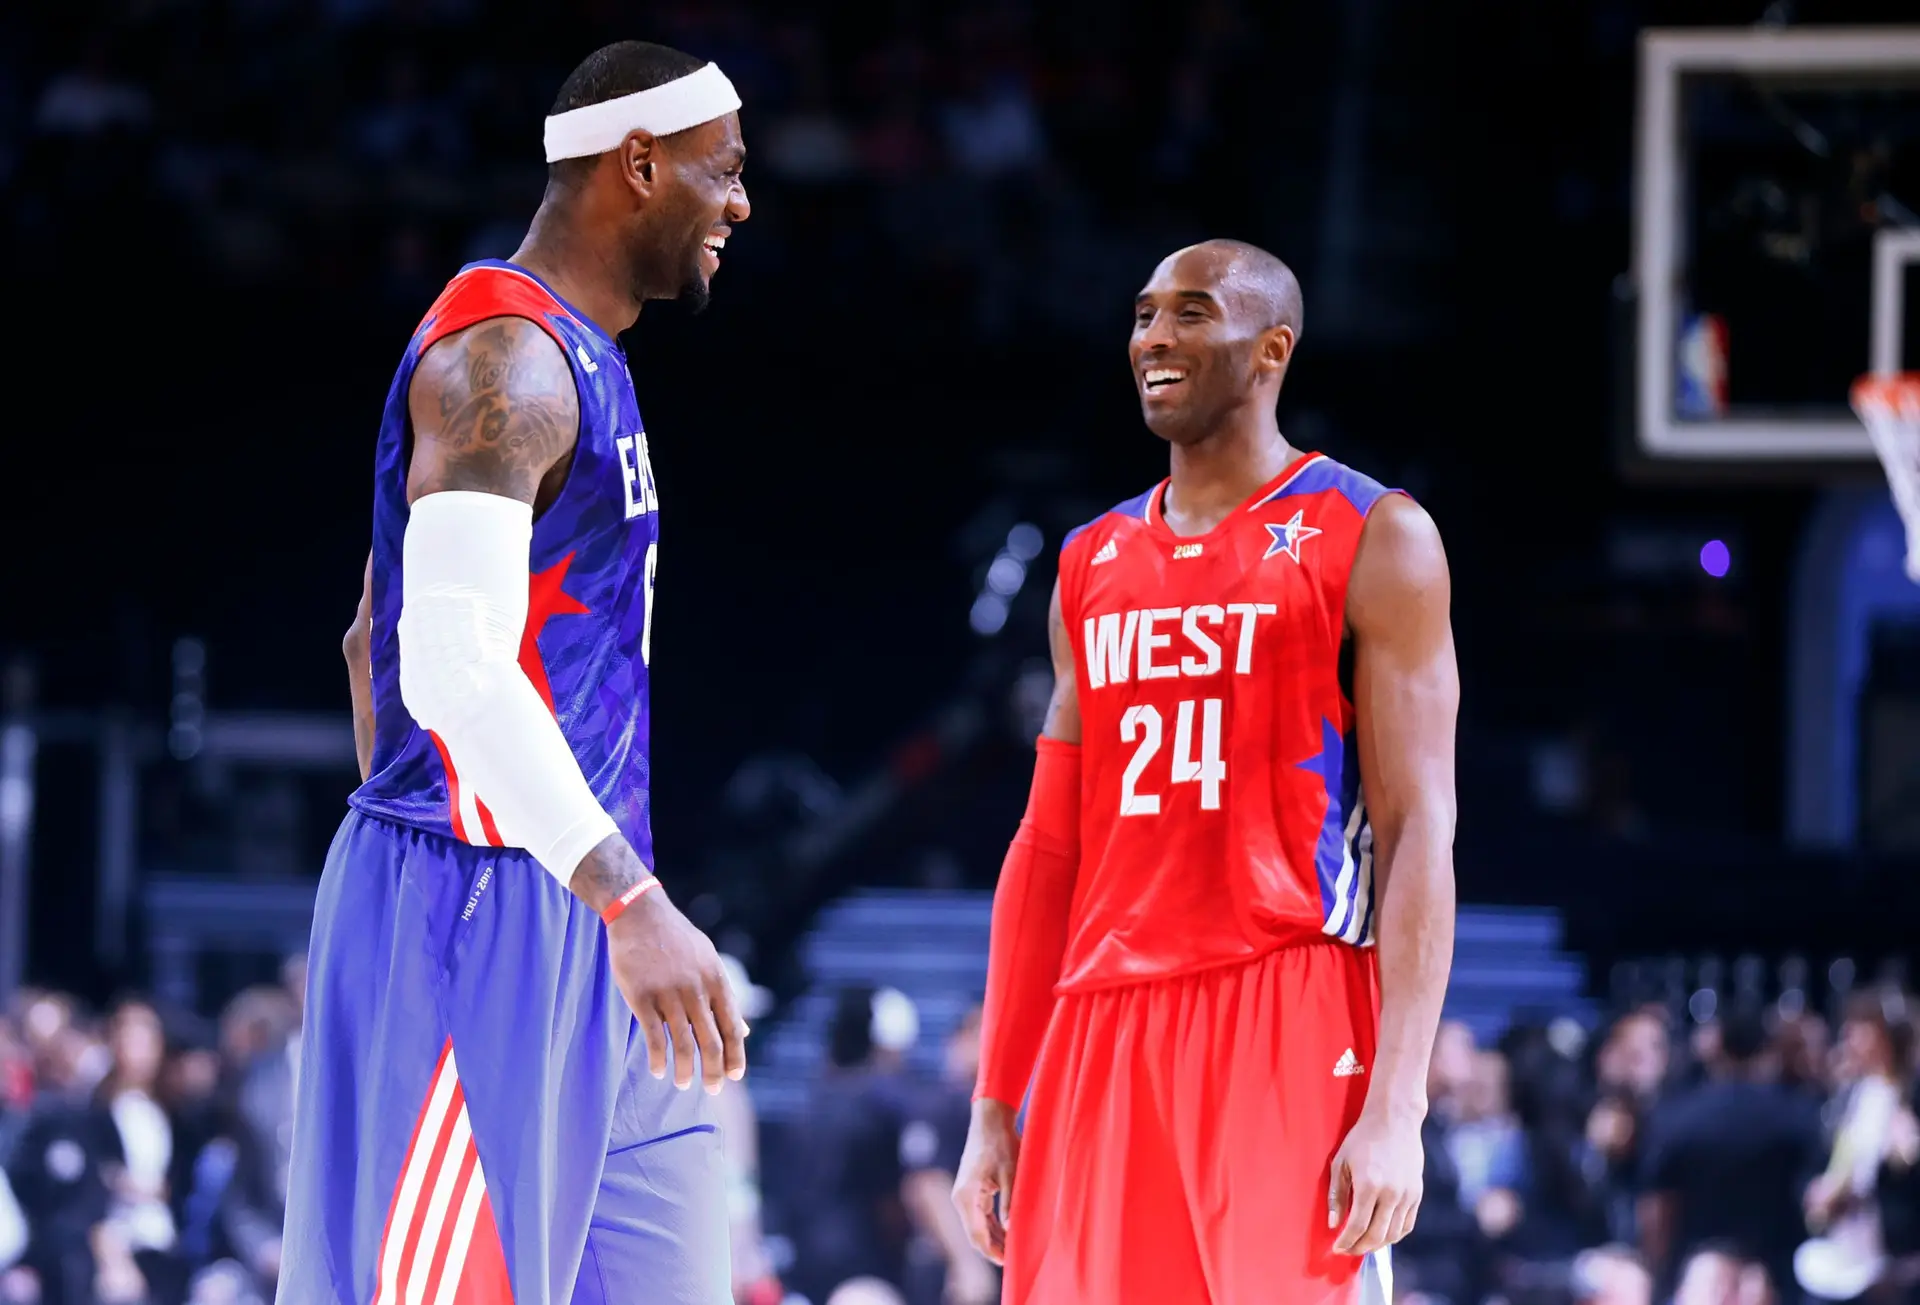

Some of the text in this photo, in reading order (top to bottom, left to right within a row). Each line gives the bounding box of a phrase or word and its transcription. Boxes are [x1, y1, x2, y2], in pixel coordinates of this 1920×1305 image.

[1084, 603, 1277, 690] WEST
[1120, 699, 1226, 816] 24
[461, 866, 493, 921] HOU 2013
